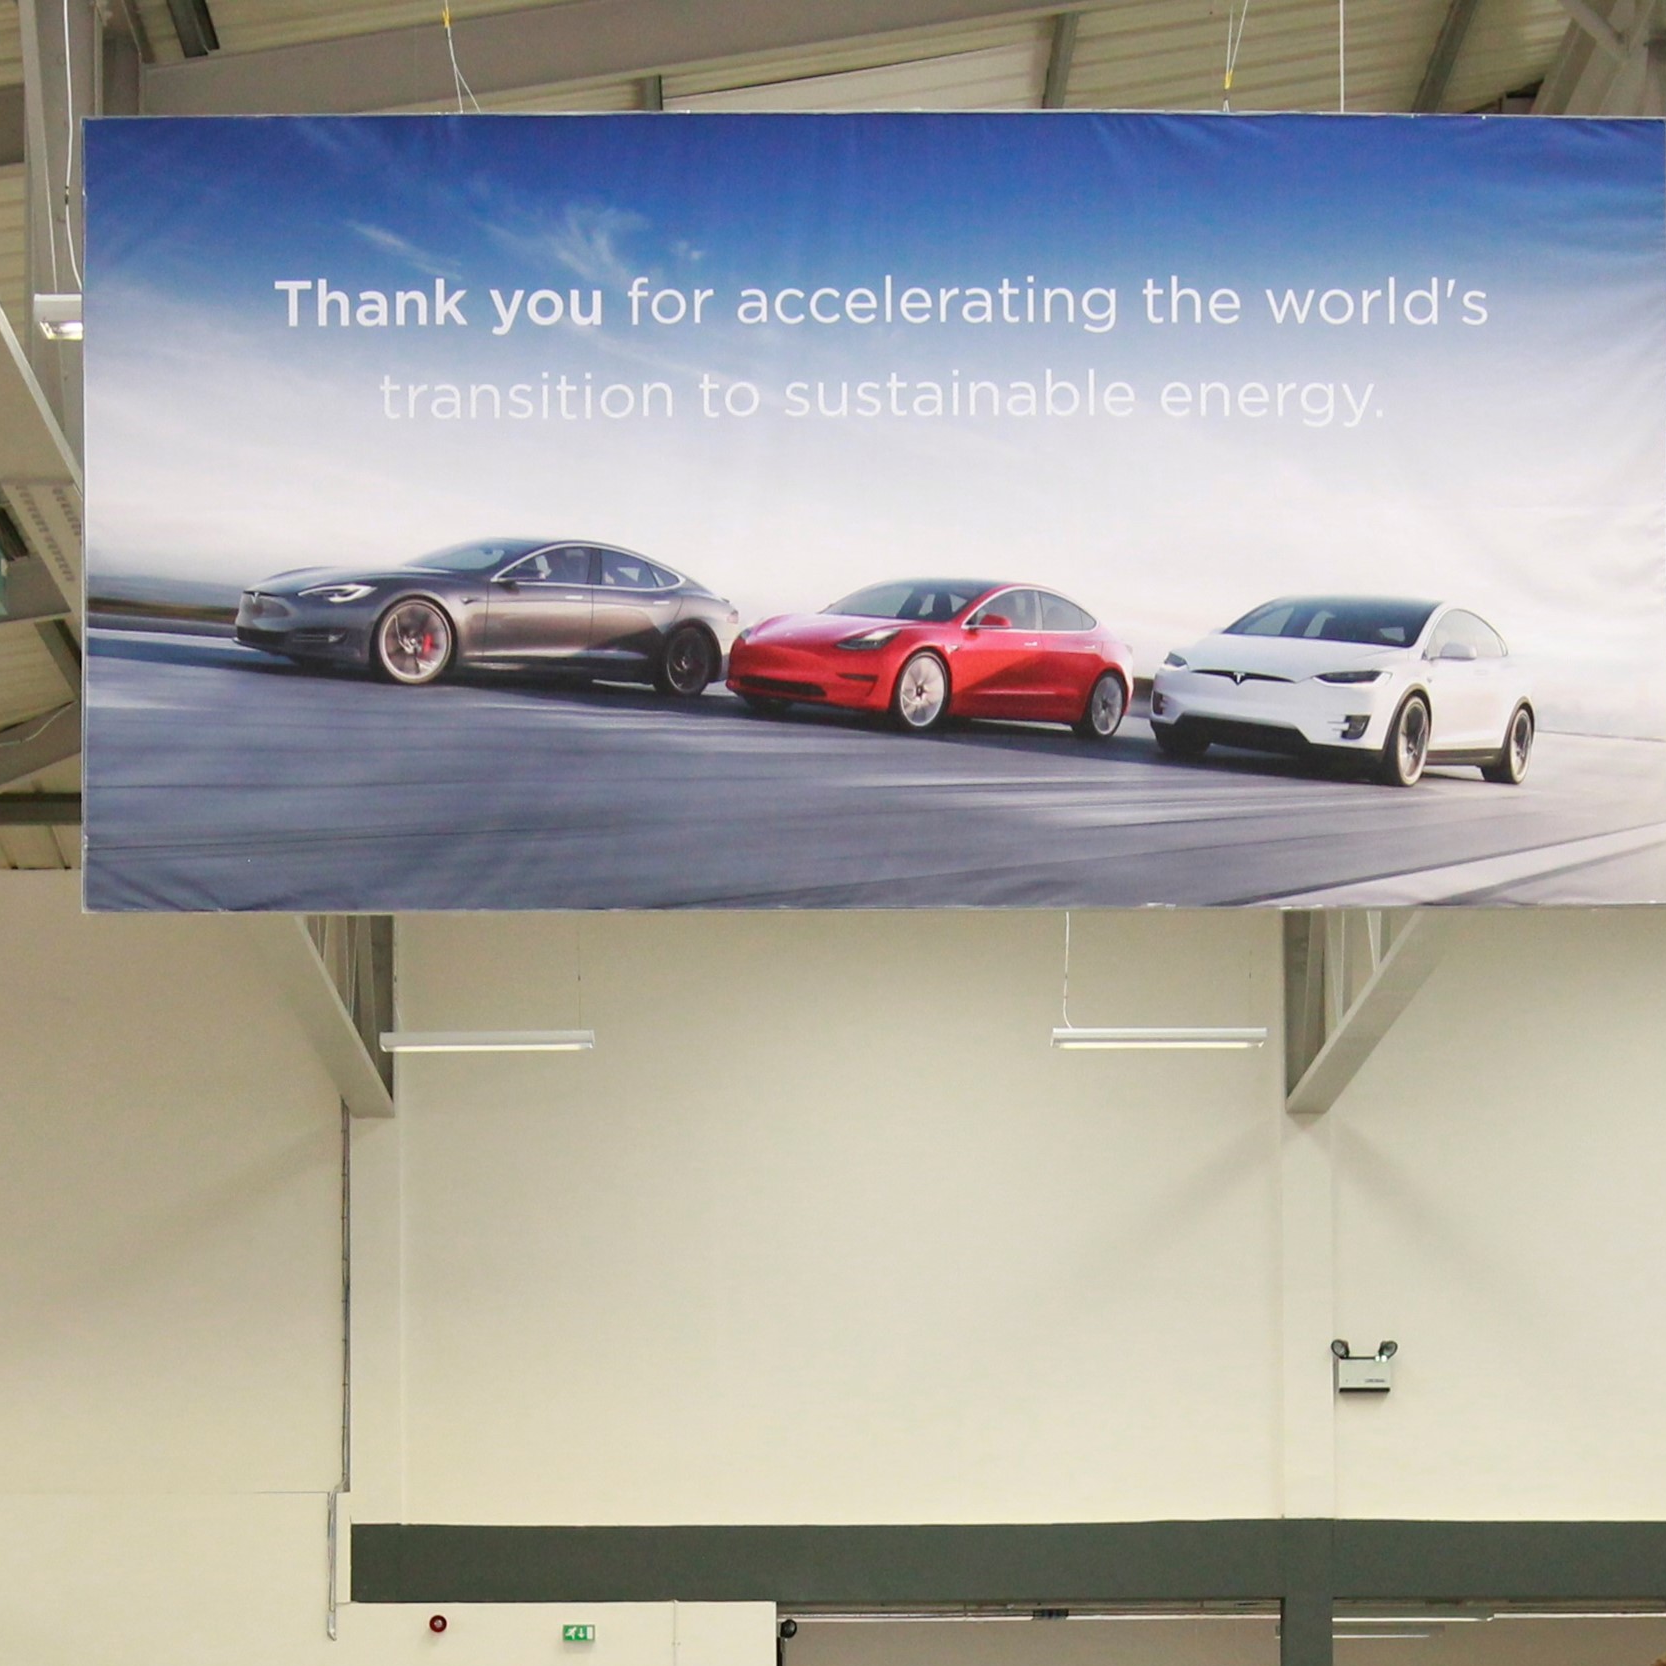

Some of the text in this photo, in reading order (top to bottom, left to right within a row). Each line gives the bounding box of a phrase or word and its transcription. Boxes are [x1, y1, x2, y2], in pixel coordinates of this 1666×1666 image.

[274, 275, 1488, 335] Thank you for accelerating the world's
[380, 369, 1383, 428] transition to sustainable energy.
